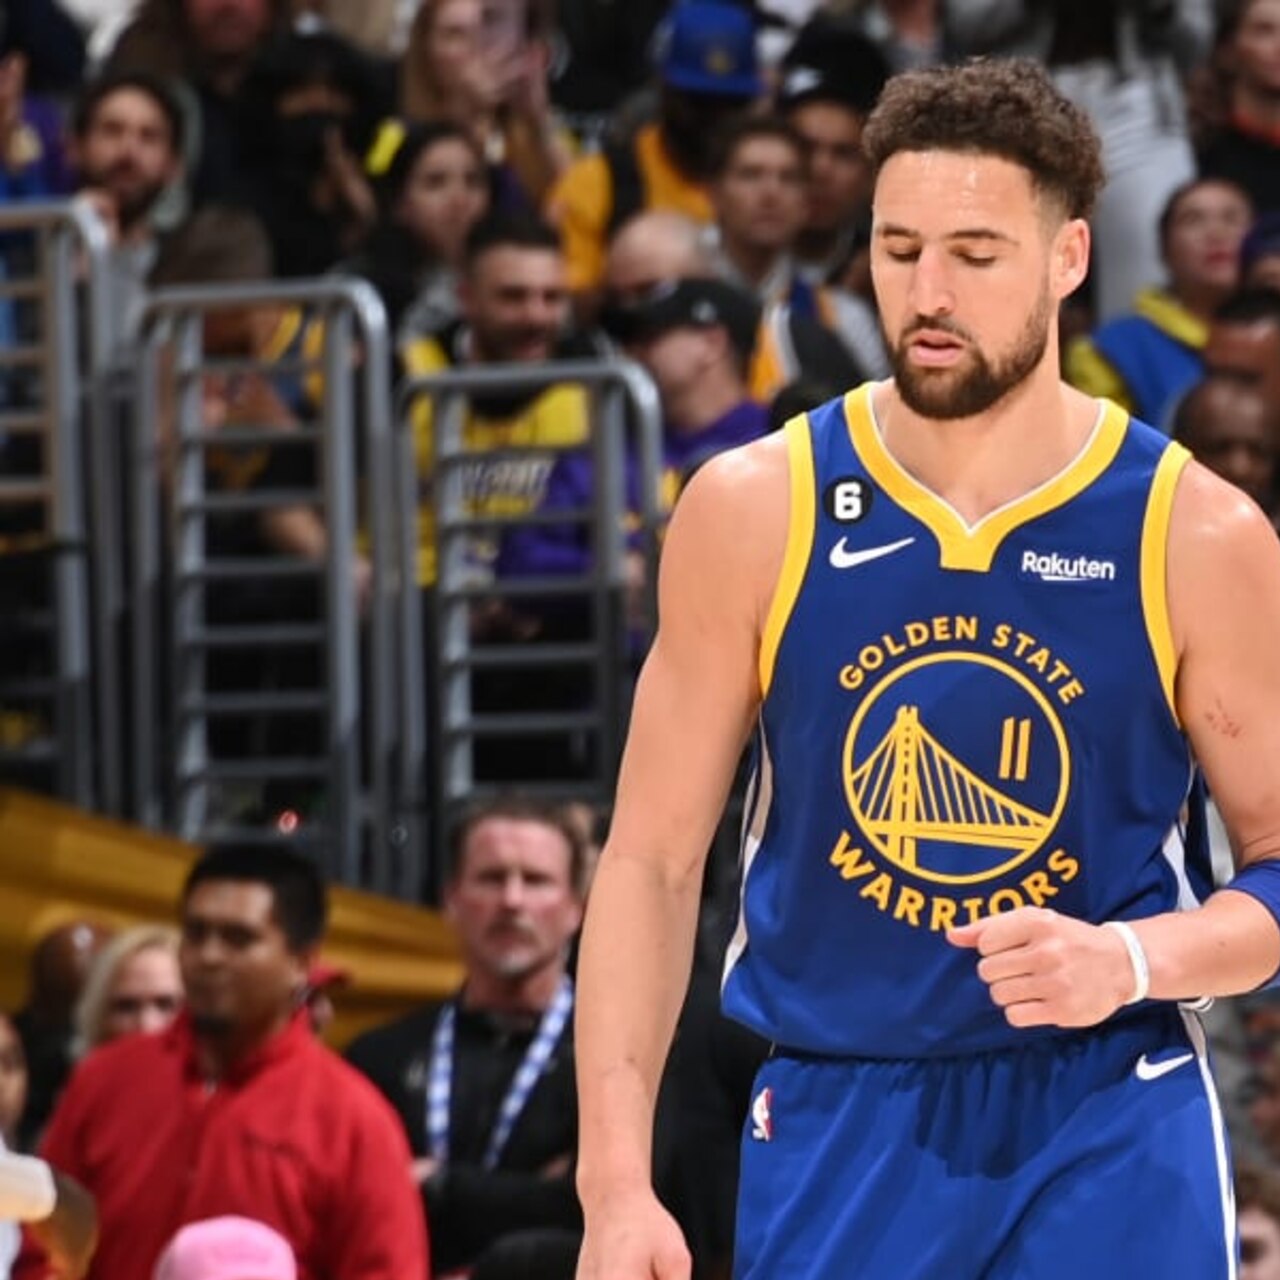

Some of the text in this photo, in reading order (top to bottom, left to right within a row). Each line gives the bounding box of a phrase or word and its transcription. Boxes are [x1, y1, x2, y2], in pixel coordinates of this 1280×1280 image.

[834, 482, 863, 520] 6
[1020, 549, 1116, 582] Rakuten
[838, 615, 1085, 706] GOLDEN STATE
[998, 716, 1032, 781] 11
[829, 829, 1080, 933] WARRIORS
